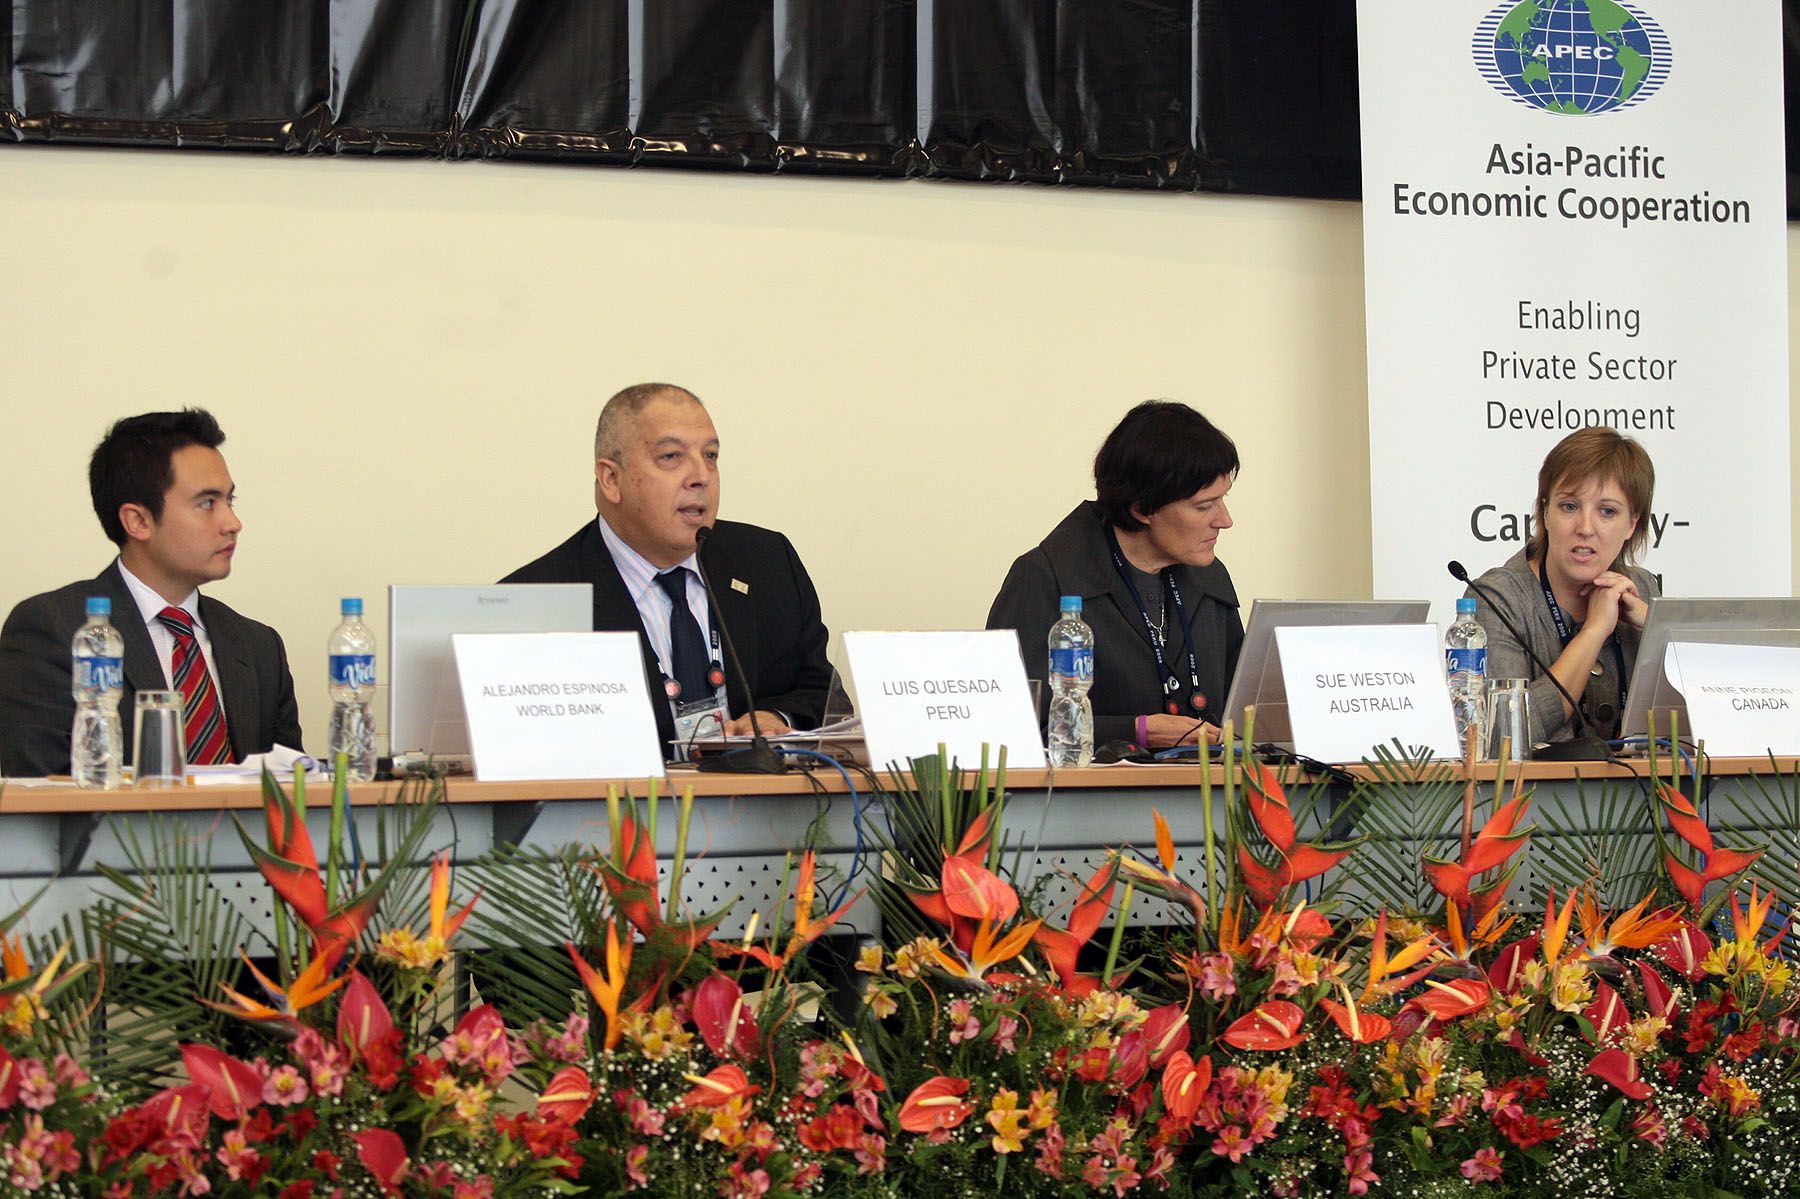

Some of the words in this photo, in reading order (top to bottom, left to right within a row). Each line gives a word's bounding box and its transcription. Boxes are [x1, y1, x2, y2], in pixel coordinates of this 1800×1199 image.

[1531, 43, 1614, 60] APEC
[1486, 143, 1666, 180] Asia-Pacific
[1393, 183, 1547, 219] Economic
[1557, 188, 1750, 228] Cooperation
[1518, 300, 1640, 337] Enabling
[1482, 351, 1576, 380] Private
[1588, 351, 1677, 381] Sector
[1486, 400, 1676, 430] Development
[882, 680, 920, 696] LUIS
[923, 679, 1002, 695] QUESADA
[1315, 673, 1347, 689] SUE
[1350, 672, 1416, 688] WESTON
[482, 684, 561, 698] ALEJANDRO
[562, 682, 628, 696] ESPINOSA
[516, 704, 565, 718] WORLD
[569, 703, 604, 717] BANK
[1330, 696, 1414, 714] AUSTRALIA
[1731, 697, 1790, 711] CANADA
[926, 705, 971, 721] PERU
